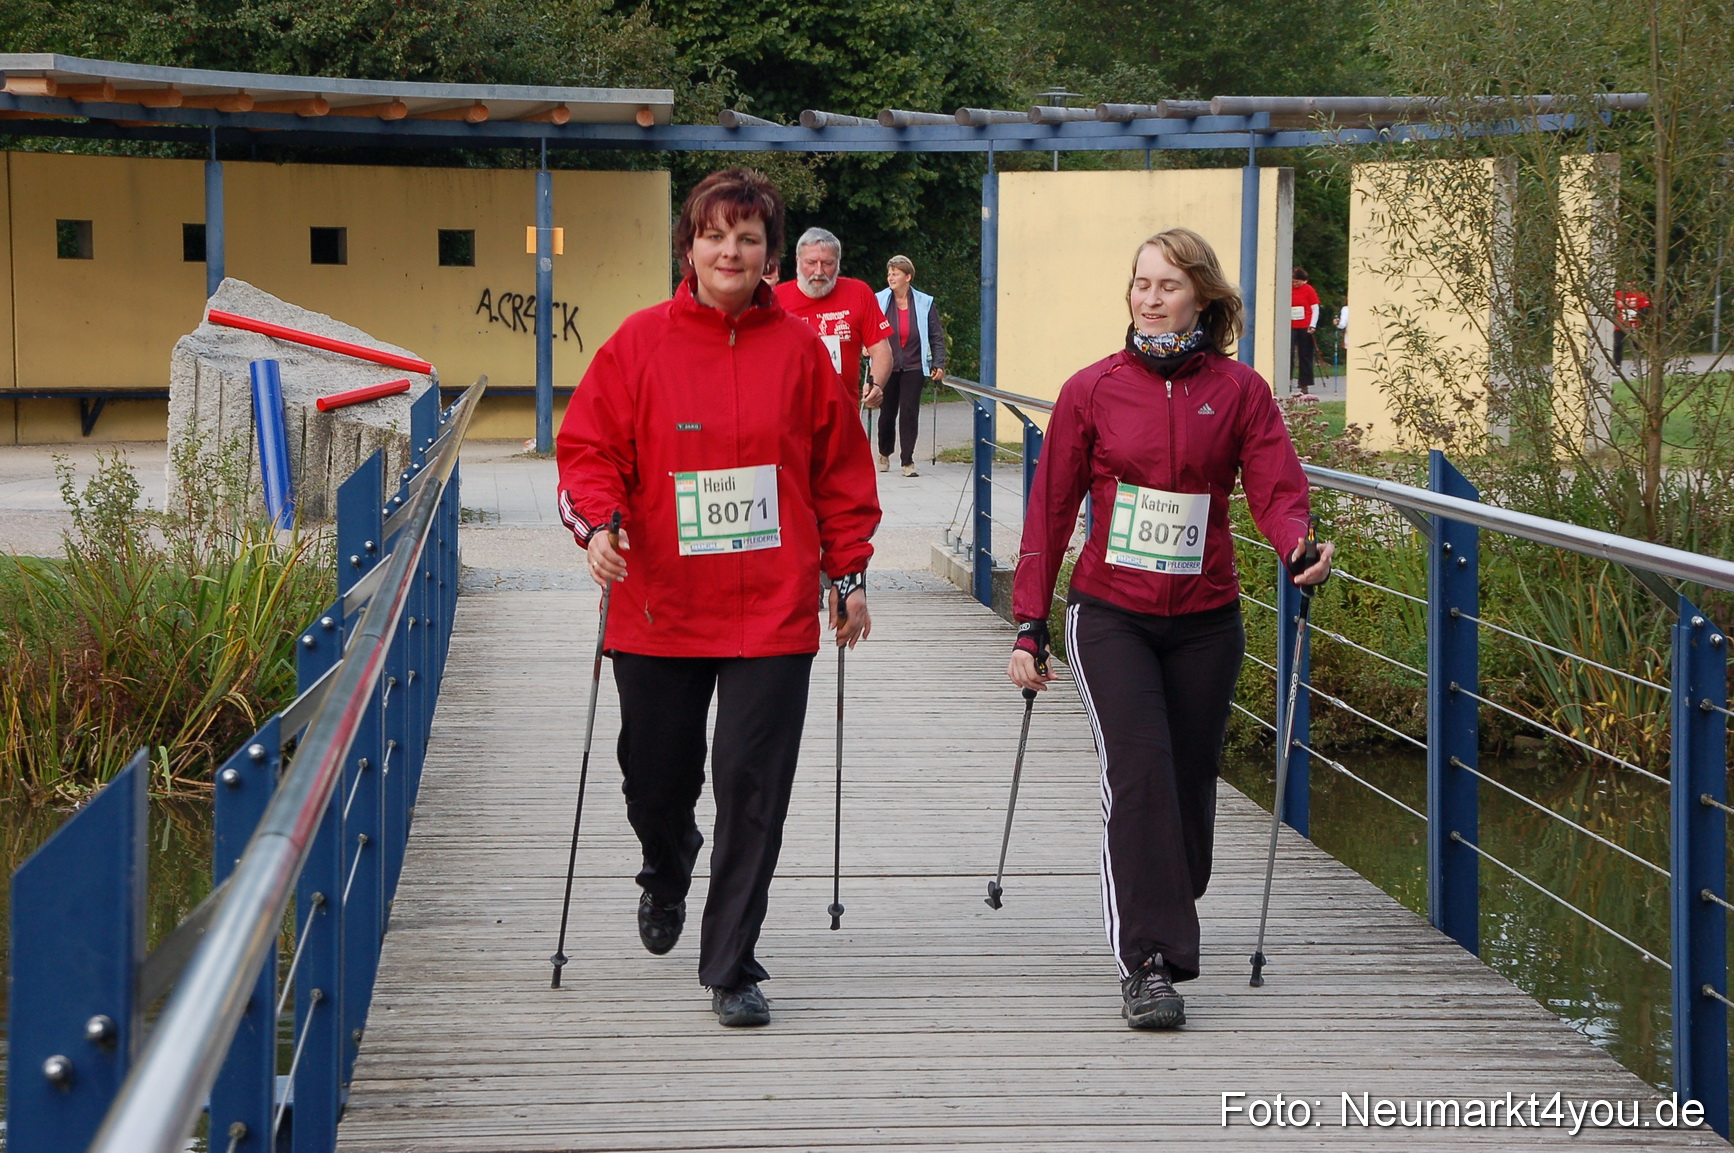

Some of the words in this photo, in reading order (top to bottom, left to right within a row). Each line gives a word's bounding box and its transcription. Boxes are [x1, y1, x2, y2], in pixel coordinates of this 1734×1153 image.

[703, 476, 736, 493] Heidi
[708, 498, 768, 525] 8071
[1141, 494, 1180, 514] Katrin
[1138, 520, 1200, 547] 8079
